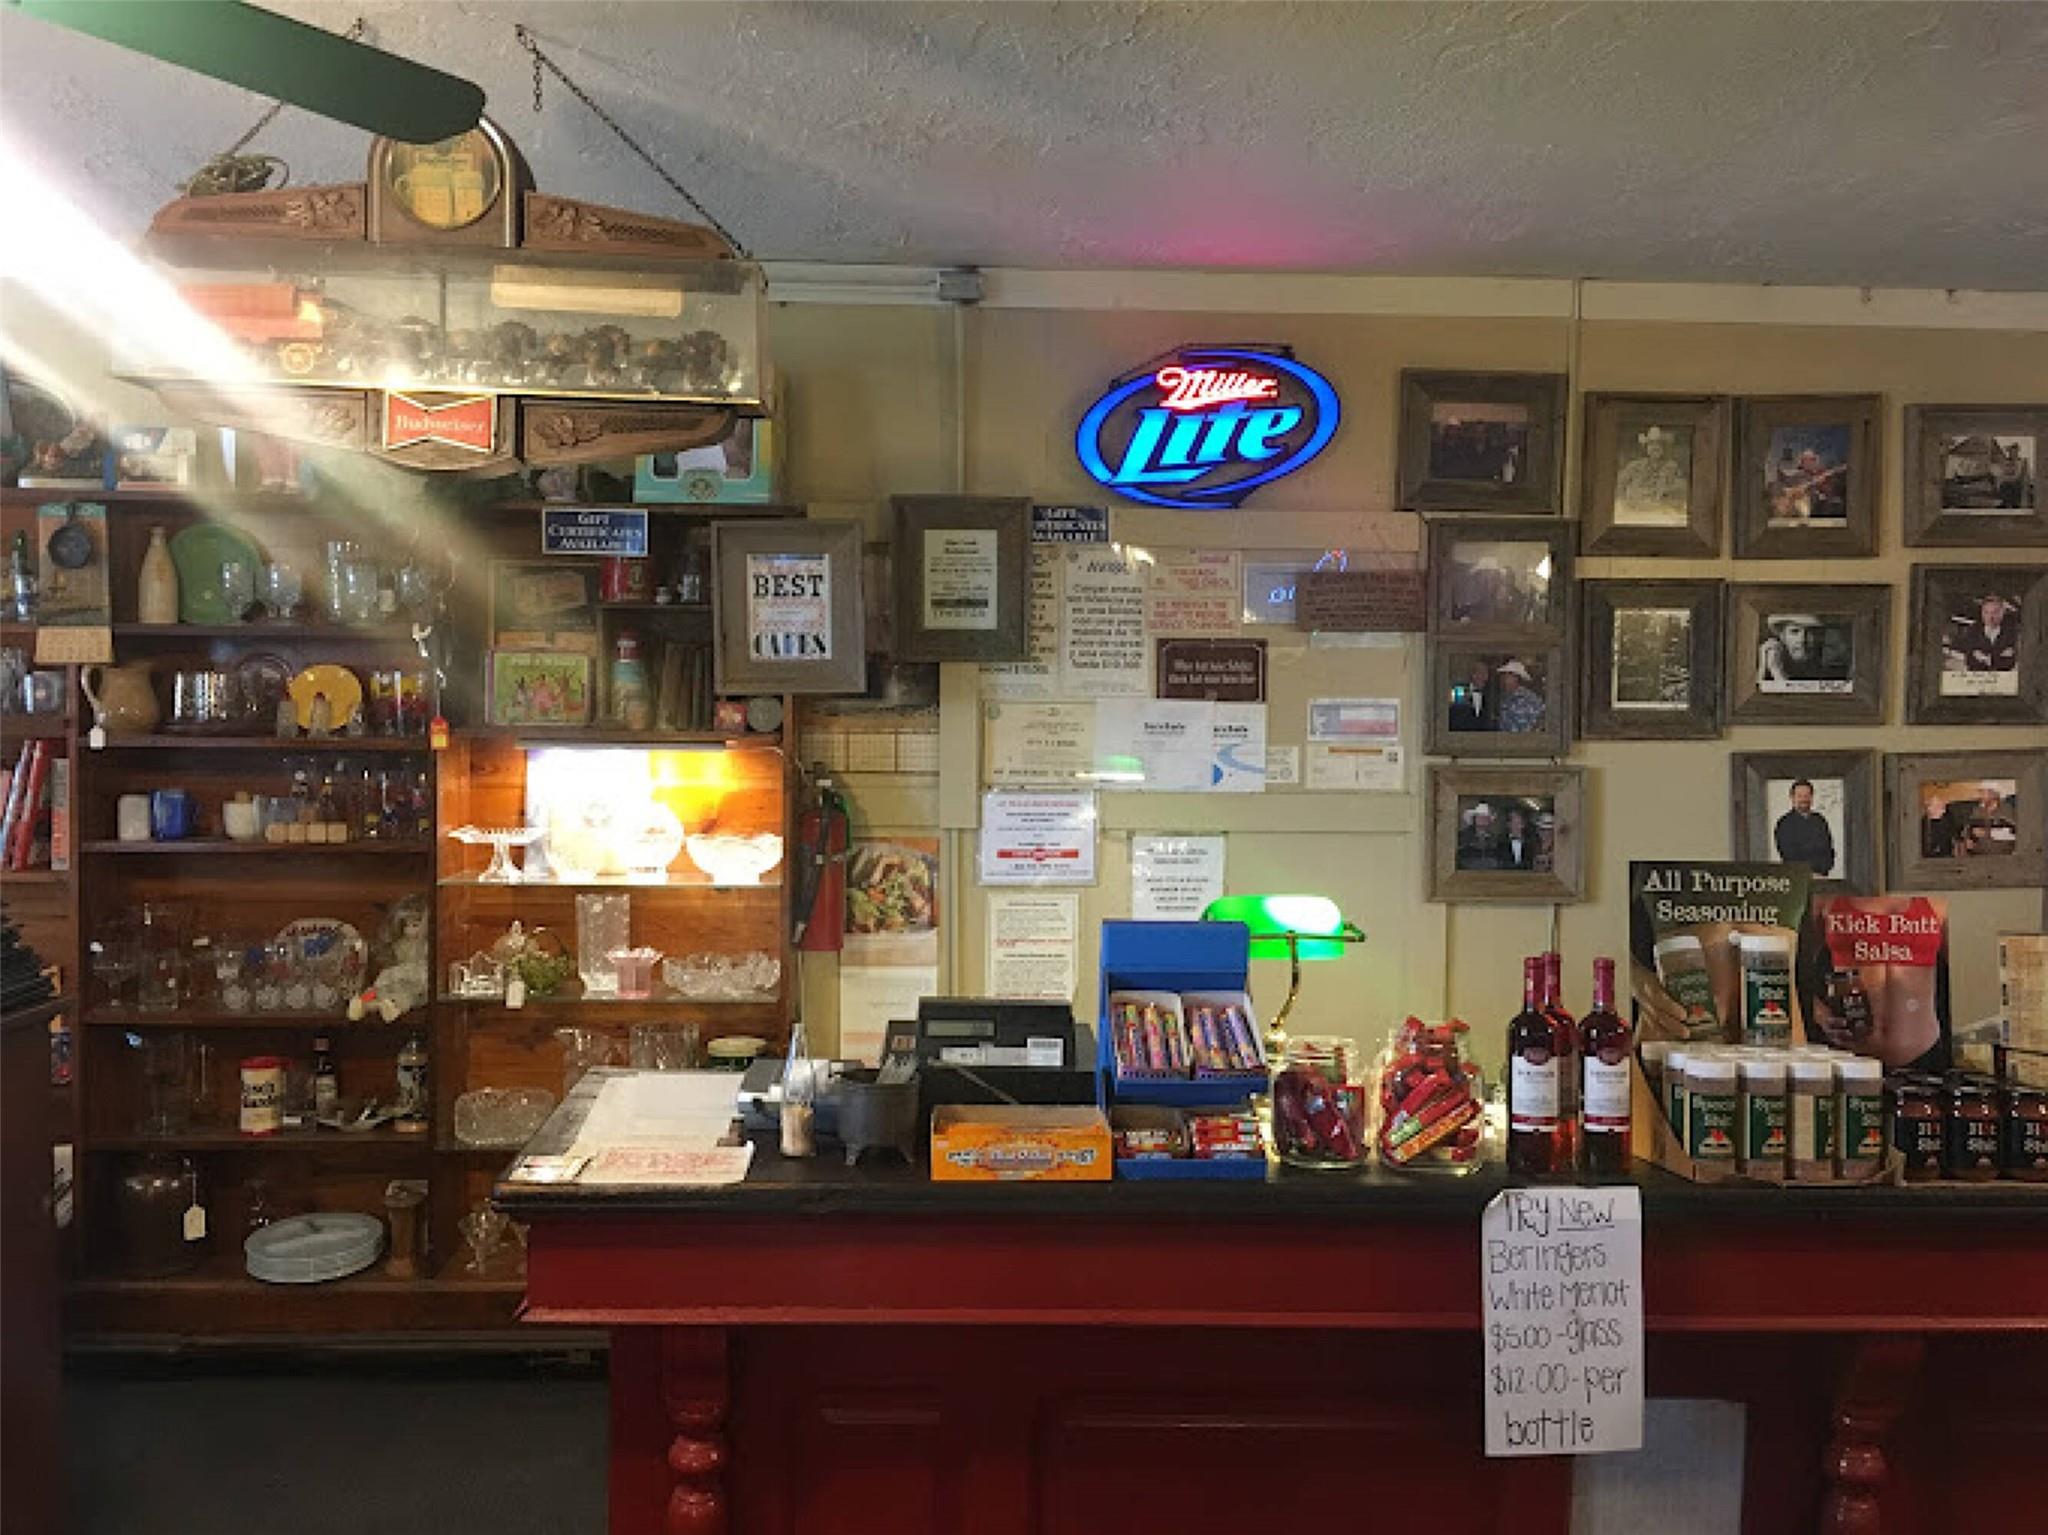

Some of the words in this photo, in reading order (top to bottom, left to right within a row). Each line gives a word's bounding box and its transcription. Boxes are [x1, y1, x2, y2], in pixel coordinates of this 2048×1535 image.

[1156, 366, 1279, 410] Miller
[396, 415, 484, 432] Budweiser
[1110, 402, 1302, 483] Lite
[753, 574, 823, 598] BEST
[1643, 869, 1682, 892] All
[1691, 870, 1791, 896] Purpose
[1656, 900, 1780, 925] Seasoning
[1828, 914, 1881, 934] Kick
[1888, 914, 1940, 934] Butt
[1853, 942, 1913, 961] Salsa
[1558, 1197, 1616, 1231] New
[1487, 1239, 1607, 1277] Beringers
[1488, 1279, 1555, 1311] White
[1504, 1408, 1595, 1449] bottle
